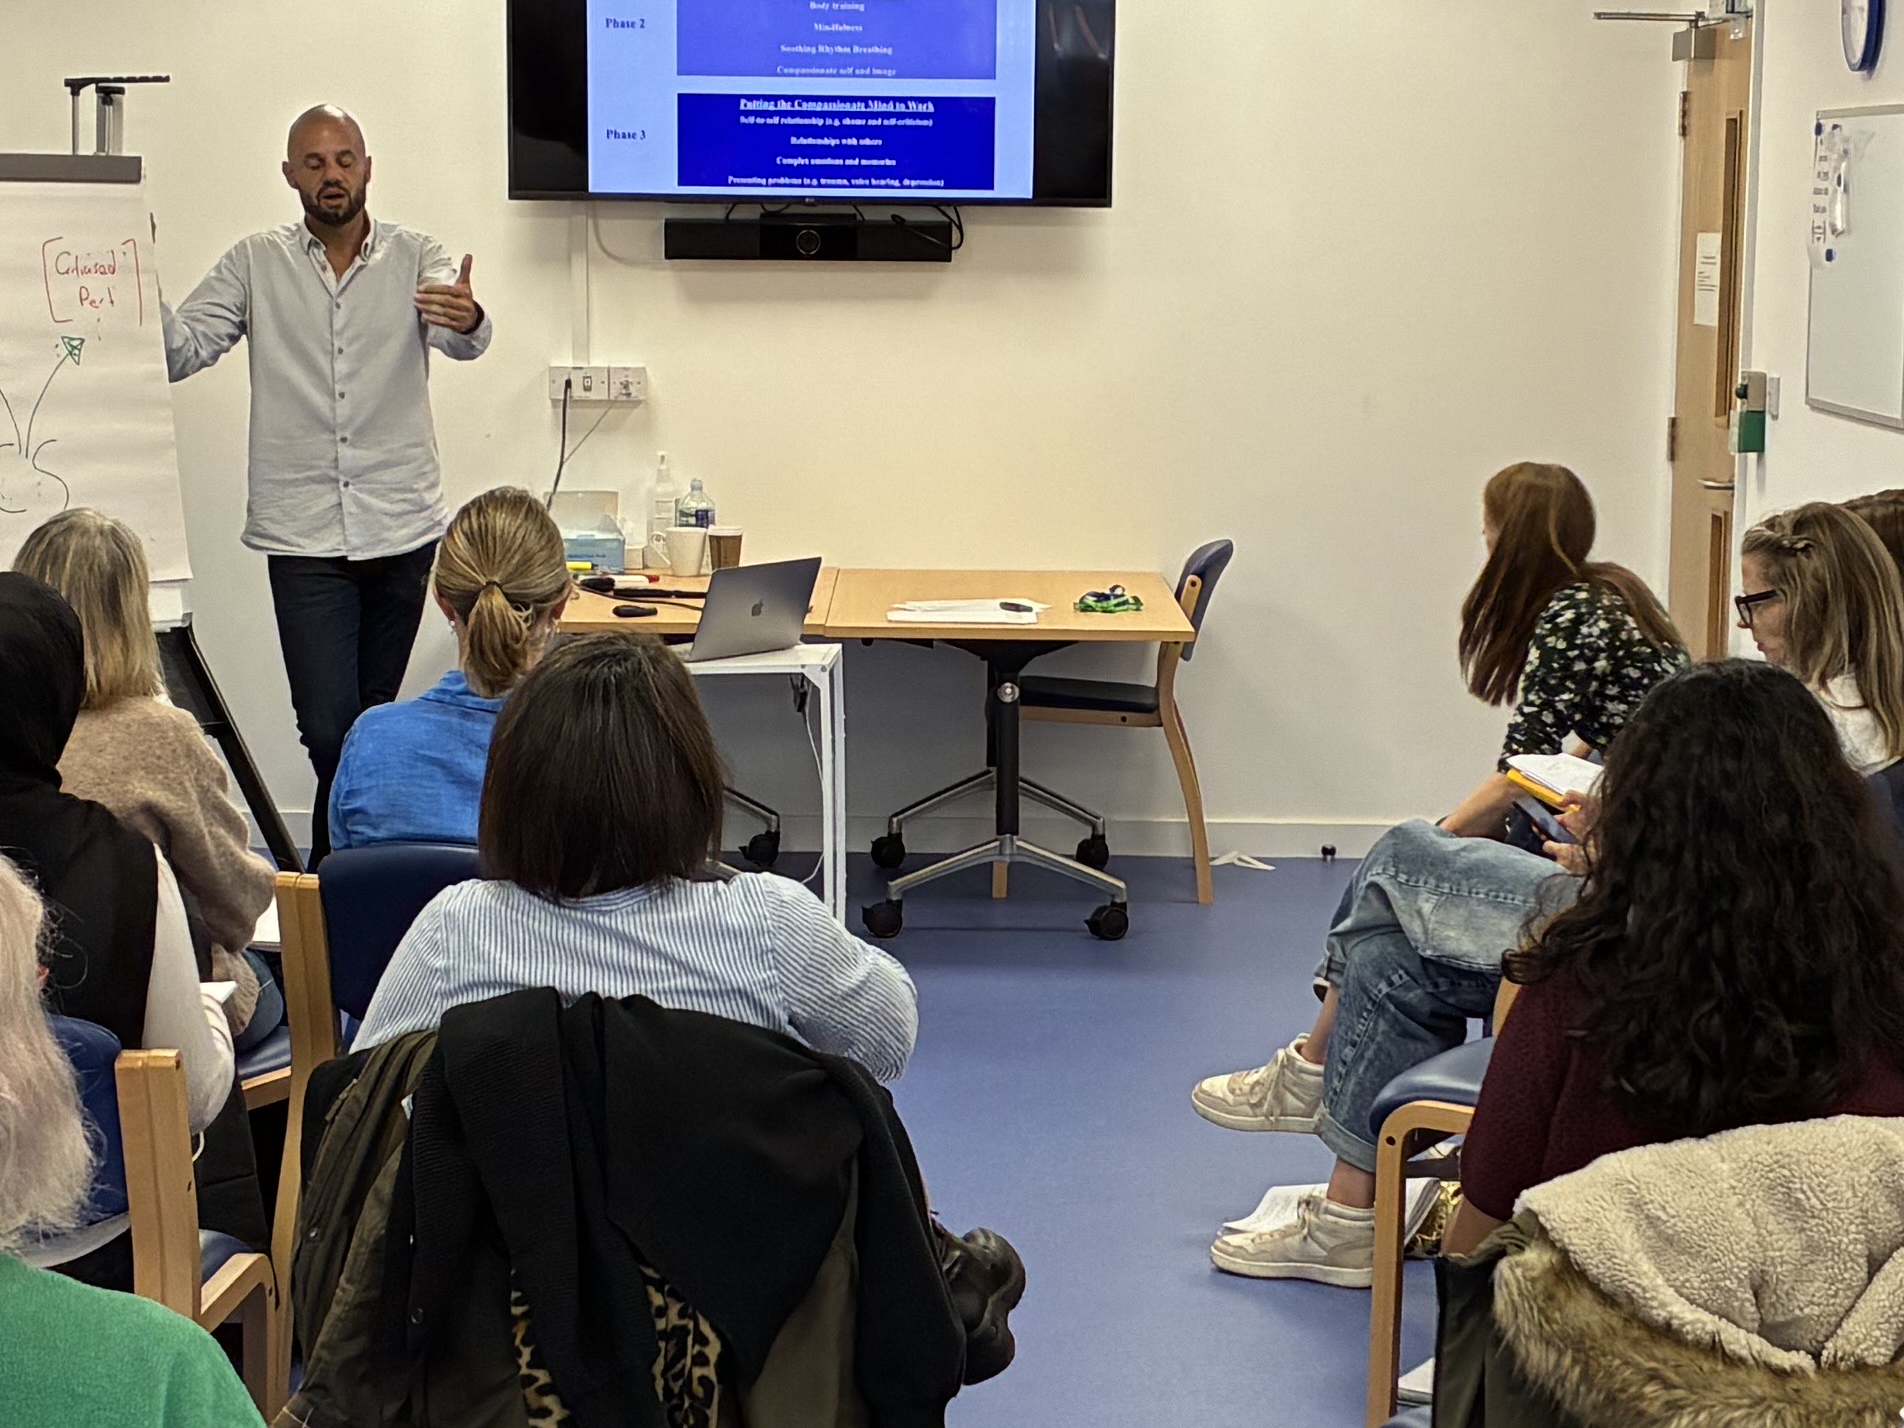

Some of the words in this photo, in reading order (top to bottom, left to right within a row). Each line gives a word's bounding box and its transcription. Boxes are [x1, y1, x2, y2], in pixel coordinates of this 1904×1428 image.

[809, 1, 830, 12] Body
[832, 2, 865, 12] training
[605, 18, 637, 29] Phase
[639, 18, 646, 29] 2
[814, 22, 863, 32] Mindfulness
[780, 44, 817, 55] Soothing
[818, 45, 851, 55] Rhythm
[853, 45, 893, 56] Breathing
[839, 66, 854, 75] self
[855, 67, 871, 75] and
[740, 98, 775, 111] Putting
[776, 99, 792, 111] the
[794, 99, 865, 112] Compassionate
[868, 100, 894, 112] Mind
[895, 101, 906, 112] to
[907, 100, 935, 113] Work
[867, 117, 882, 126] and
[606, 128, 637, 140] Phase
[639, 129, 646, 141] 3
[841, 137, 858, 146] with
[859, 137, 883, 146] others
[845, 157, 859, 166] and
